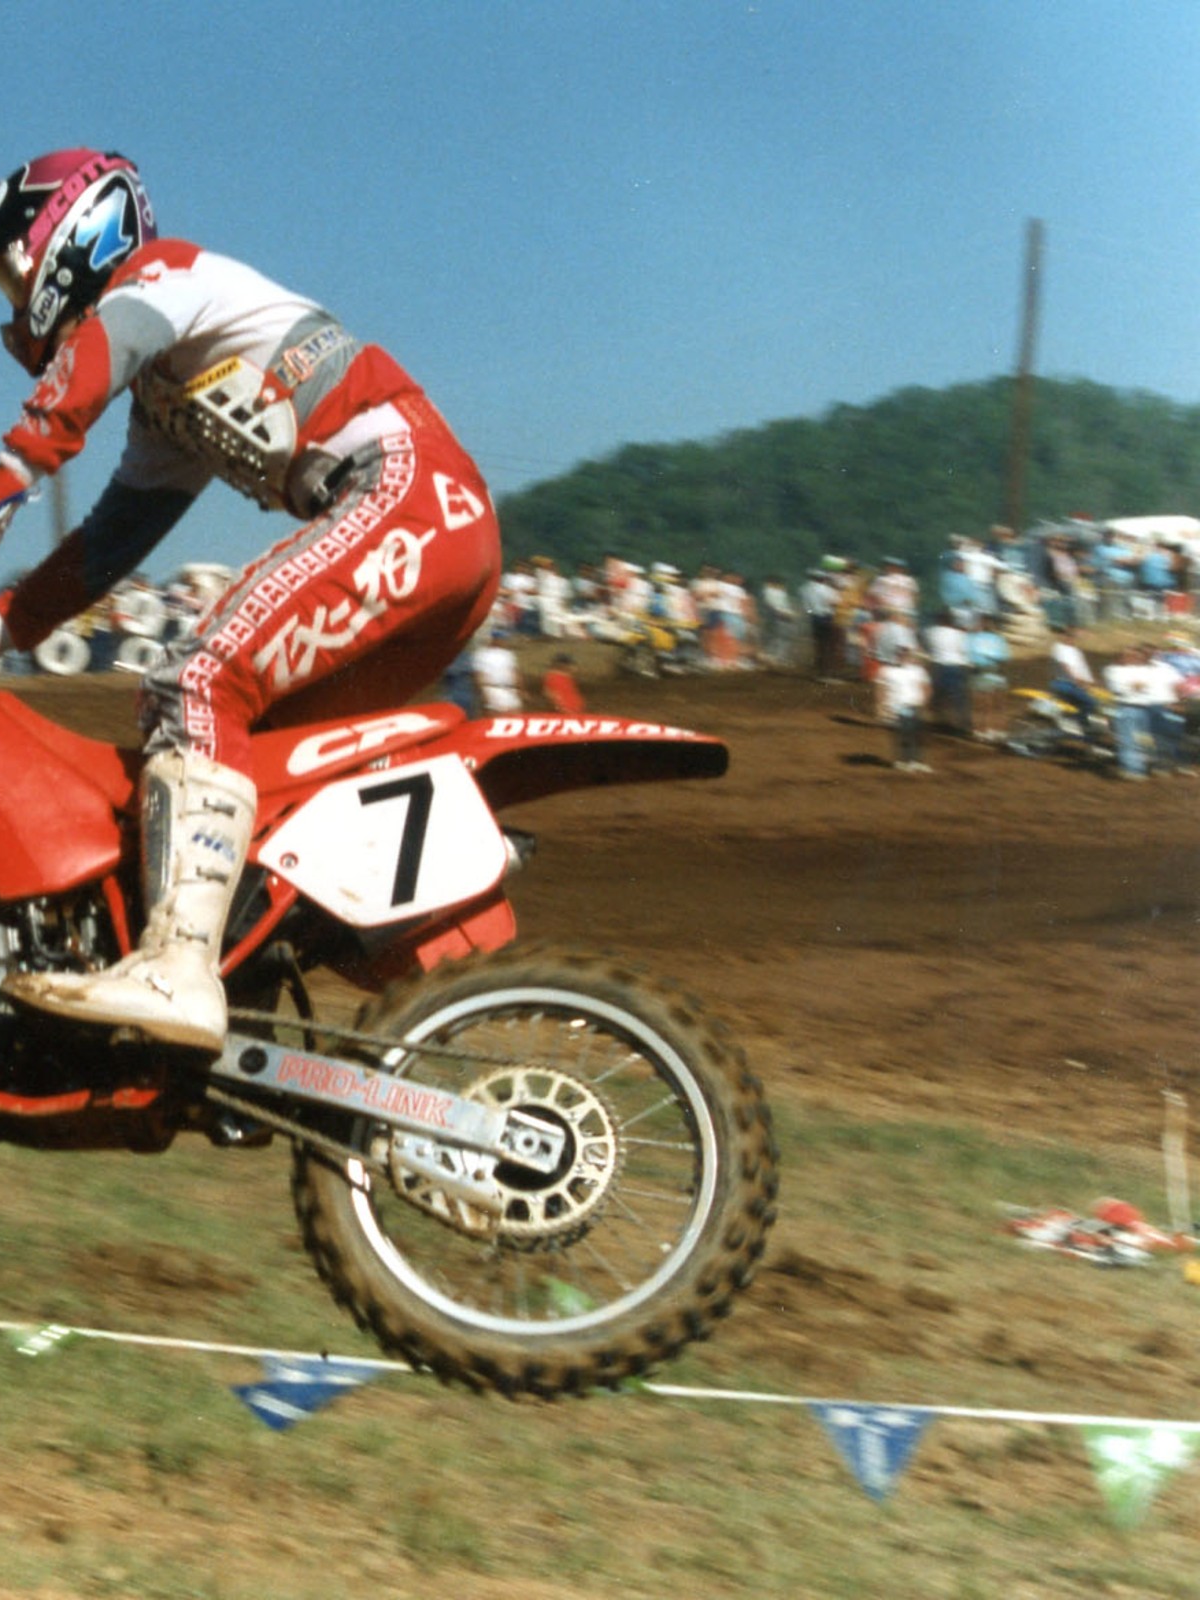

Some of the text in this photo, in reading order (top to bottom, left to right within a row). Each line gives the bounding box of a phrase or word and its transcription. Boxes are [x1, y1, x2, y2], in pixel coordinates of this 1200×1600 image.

[31, 291, 57, 335] Arai
[286, 711, 445, 777] CR
[357, 771, 435, 909] 7
[275, 1053, 453, 1128] PRO-LINK
